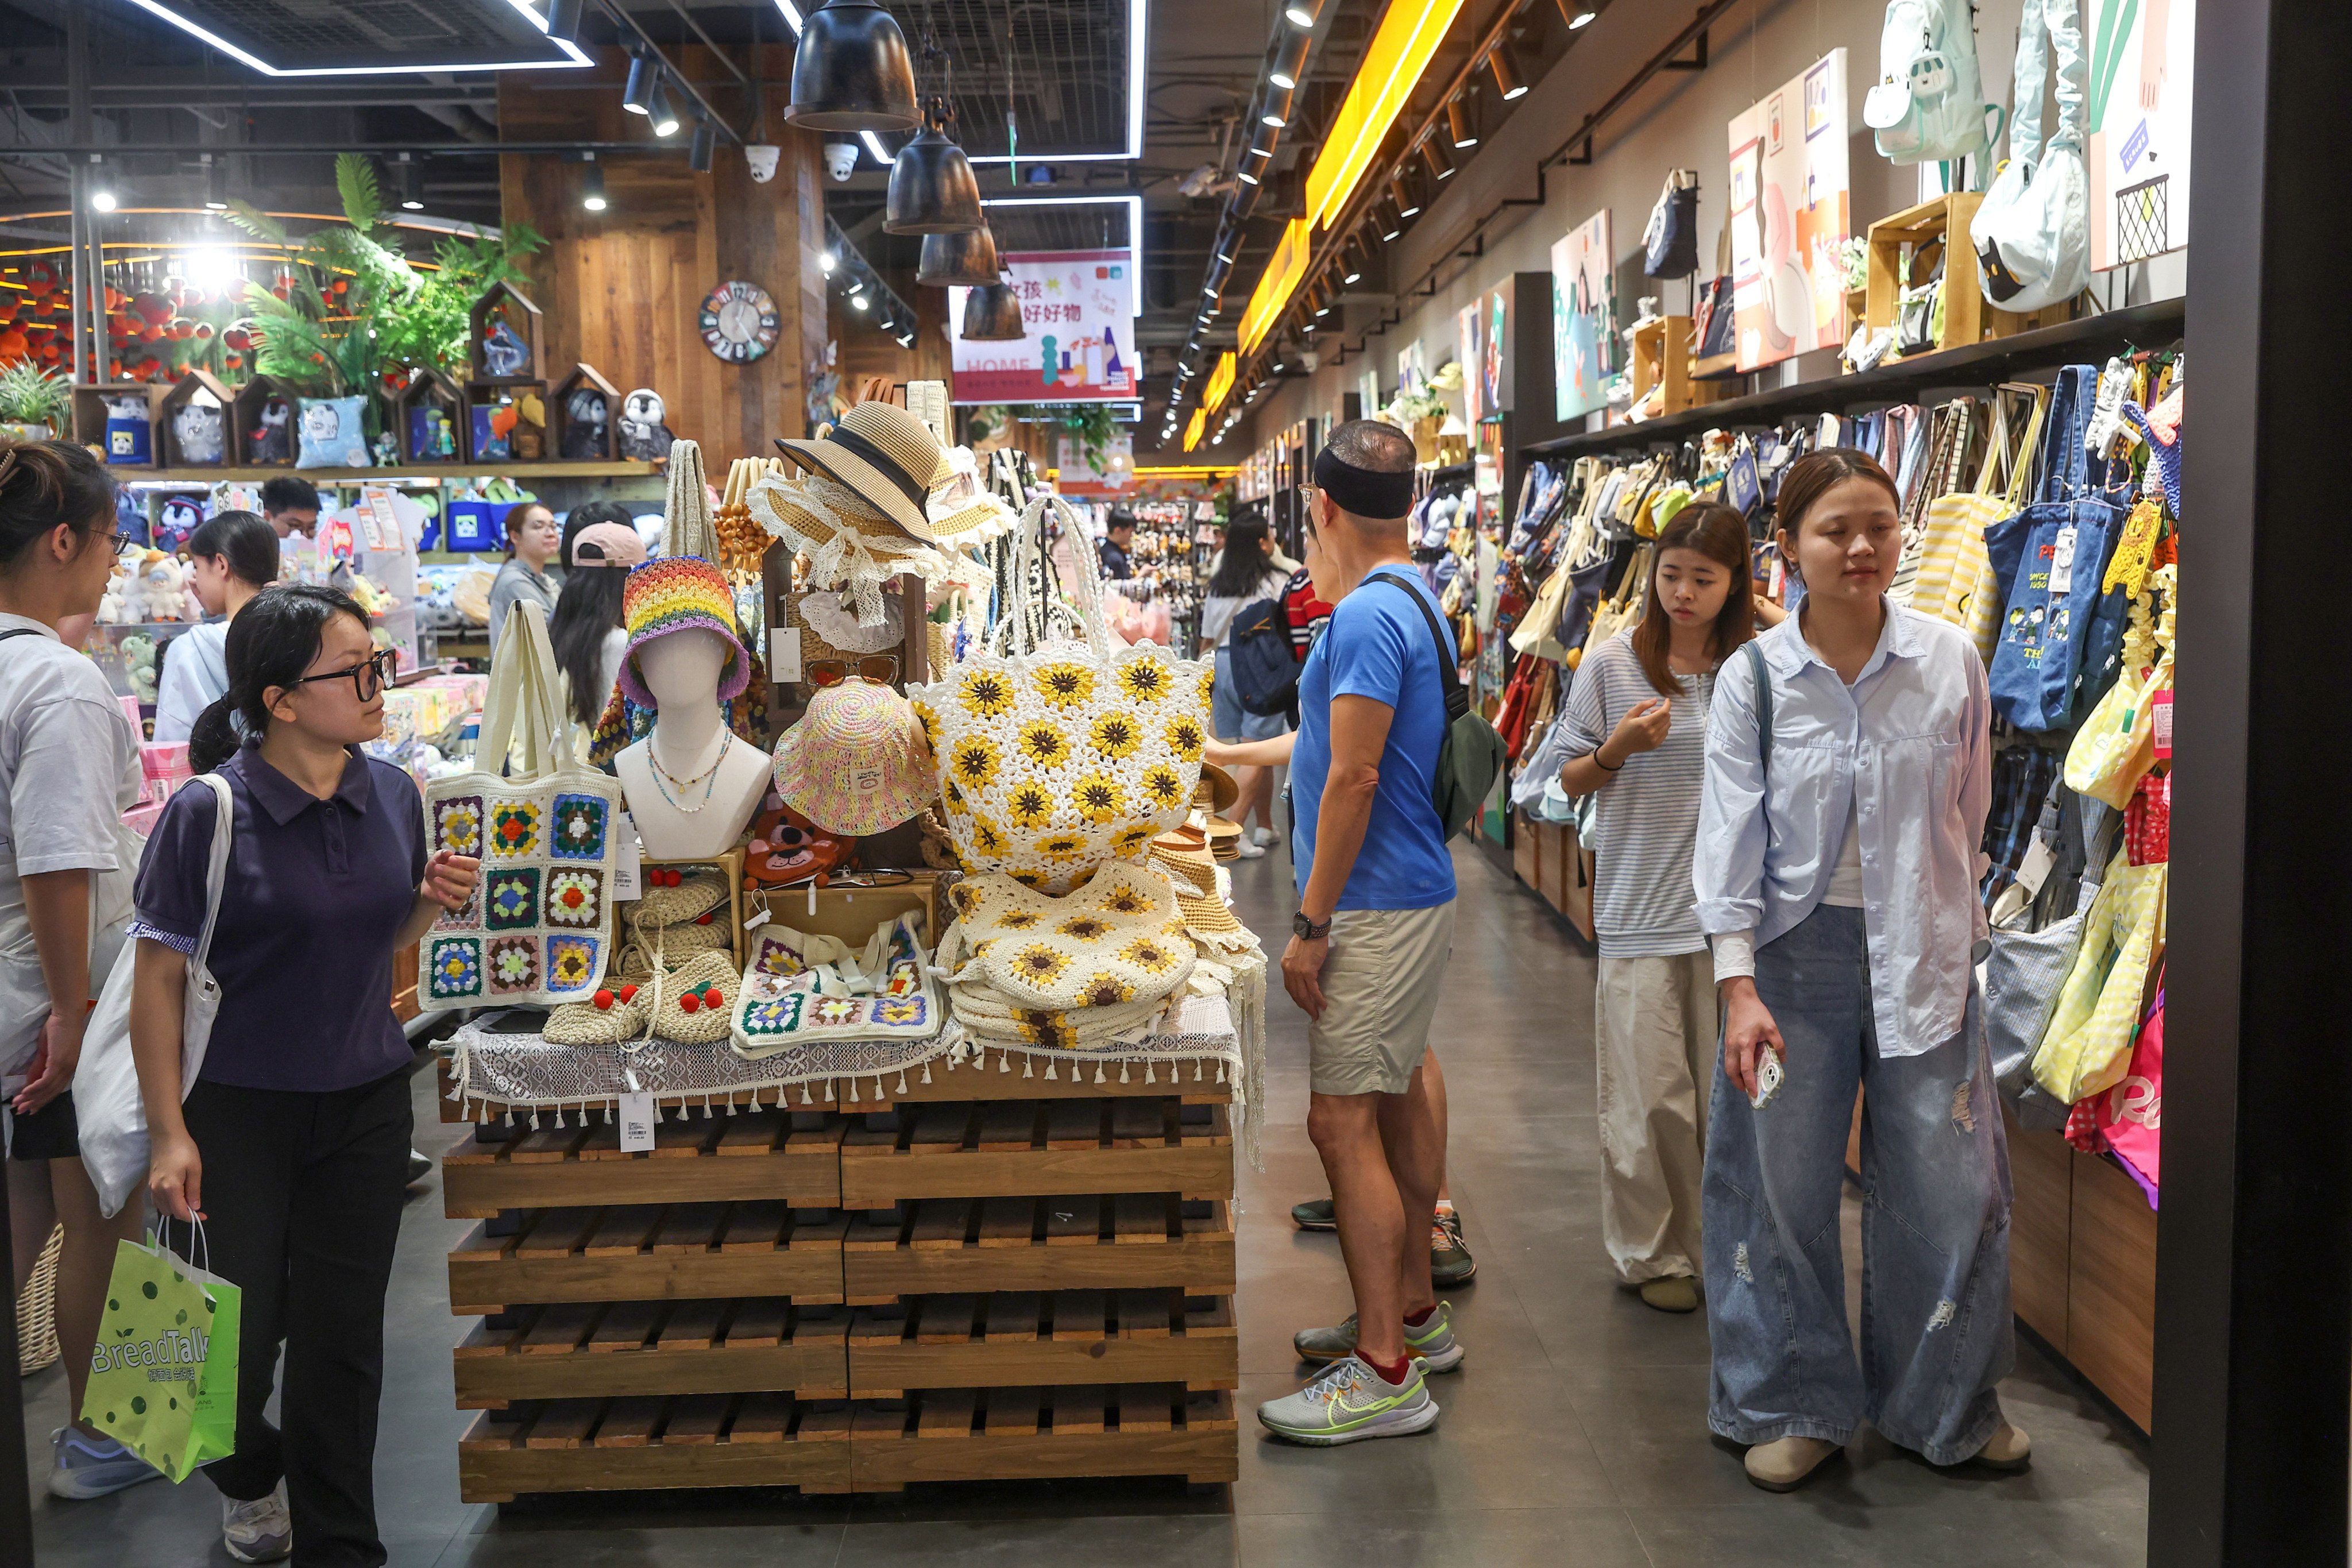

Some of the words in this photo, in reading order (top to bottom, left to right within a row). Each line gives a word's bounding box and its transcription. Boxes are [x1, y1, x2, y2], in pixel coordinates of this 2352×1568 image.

[2125, 133, 2146, 167] SCRUBS
[2029, 572, 2050, 581] SINCE
[2029, 581, 2047, 589] 1950
[91, 1326, 210, 1374] BreadTalk
